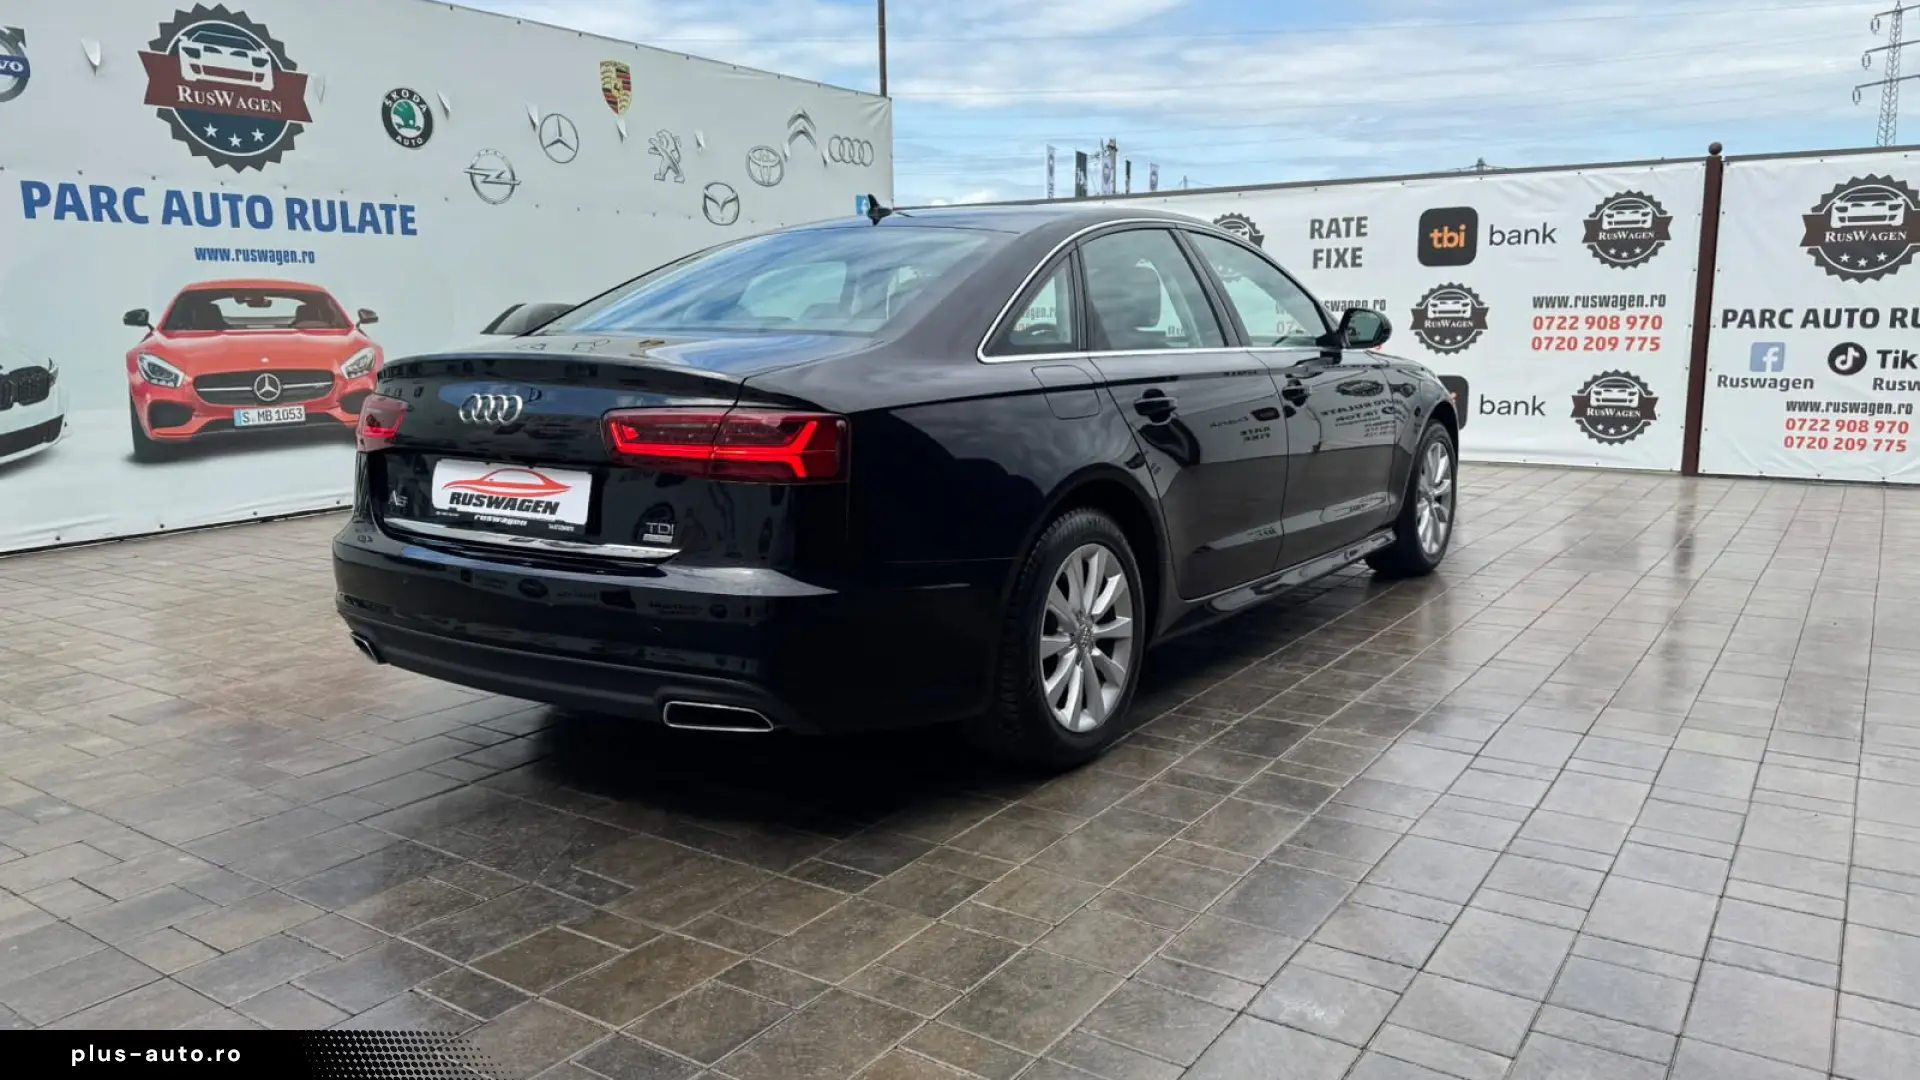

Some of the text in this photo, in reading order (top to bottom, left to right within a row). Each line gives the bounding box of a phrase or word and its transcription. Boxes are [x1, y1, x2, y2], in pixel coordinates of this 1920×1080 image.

[395, 136, 423, 146] AUTO
[20, 180, 418, 236] PARC AUTO RULATE
[1310, 216, 1368, 239] RATE
[1429, 222, 1558, 249] tbi bank
[194, 246, 315, 266] www.ruswagen.ro
[1312, 247, 1363, 269] FIXE
[1532, 294, 1666, 310] www.ruswagen.ro
[1532, 315, 1663, 331] 0722 908 970
[1721, 308, 1794, 329] PARC
[1800, 307, 1880, 329] AUTO
[1531, 336, 1661, 352] 0720 209 775
[1717, 374, 1815, 392] Ruswagen
[1480, 394, 1546, 416] bank
[1785, 399, 1913, 416] www.ruswagen.ro
[274, 407, 303, 421] 1053
[1785, 418, 1909, 435] 0722 908 970
[1784, 436, 1907, 453] 0720 209 775
[449, 491, 560, 515] RUSWAGEN
[645, 521, 674, 535] TDI
